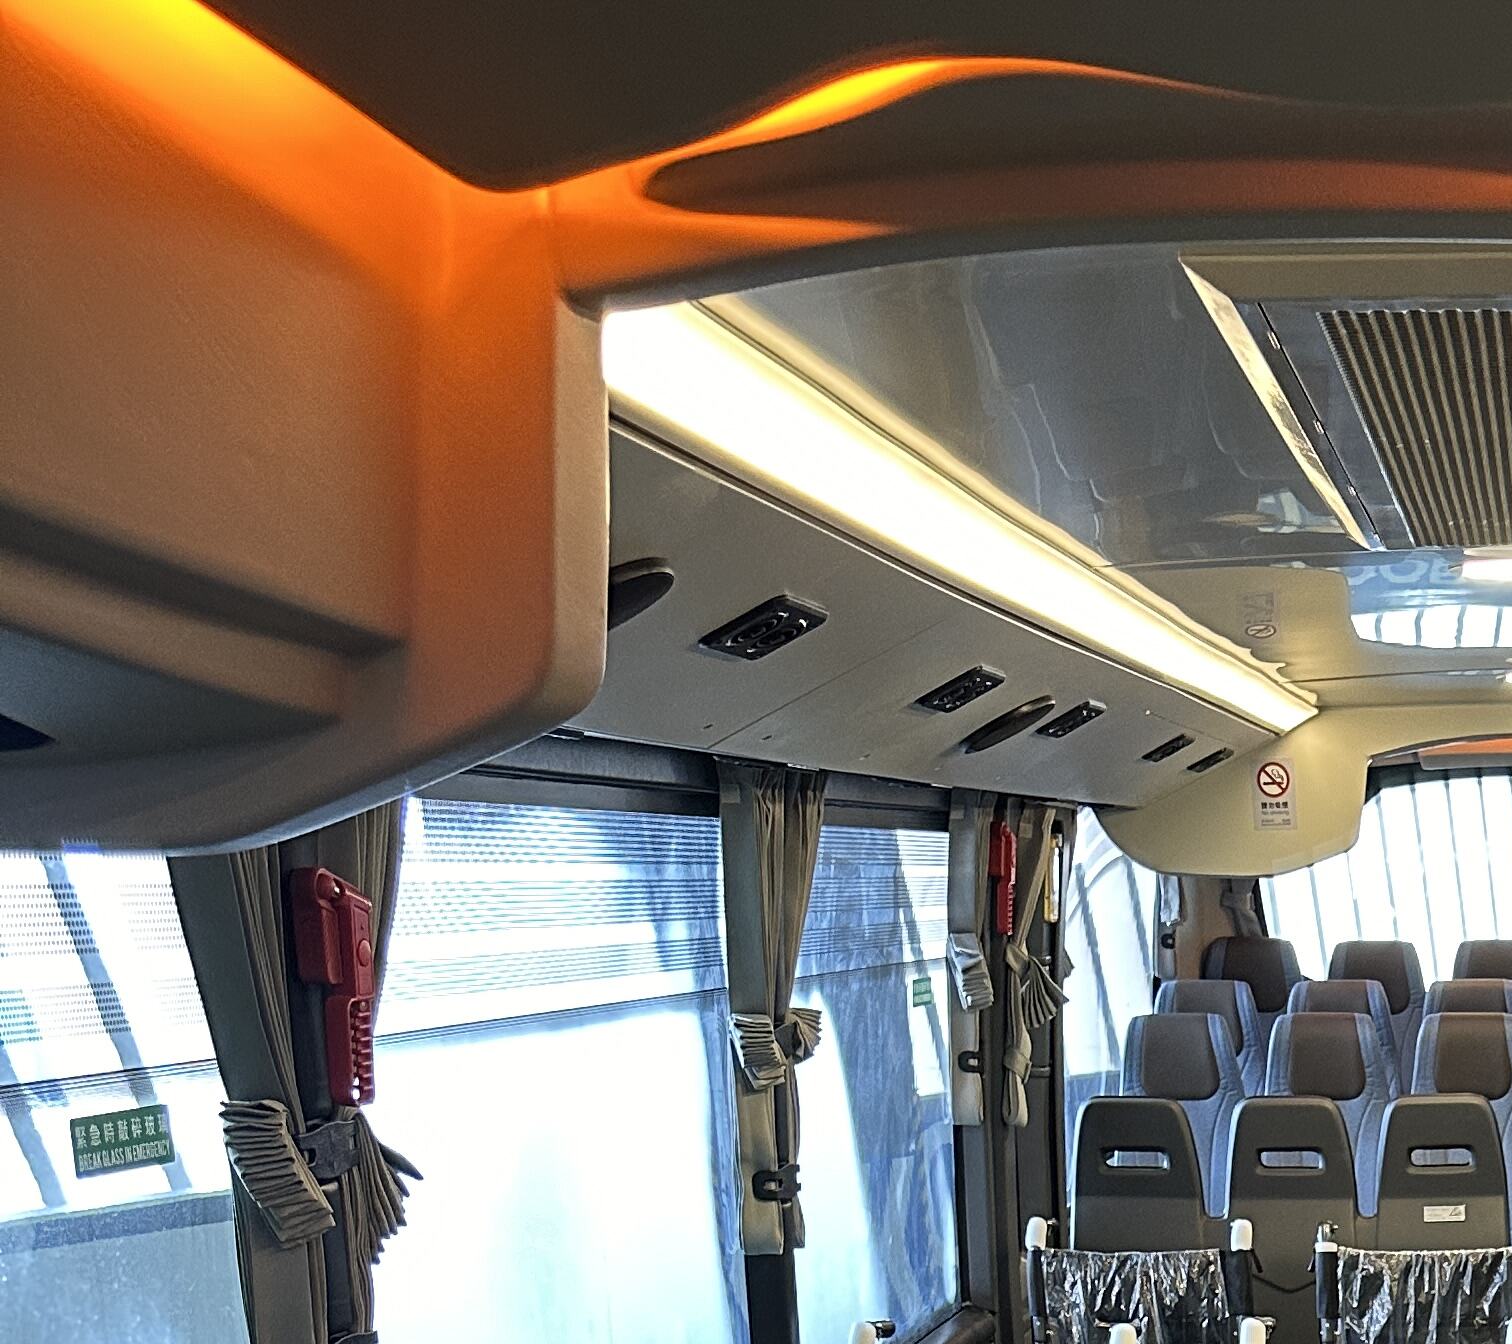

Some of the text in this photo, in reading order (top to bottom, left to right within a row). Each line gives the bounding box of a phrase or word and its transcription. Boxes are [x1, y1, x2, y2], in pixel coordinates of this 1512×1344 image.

[78, 1139, 171, 1172] BREAK GLASS IN EMERGENCY
